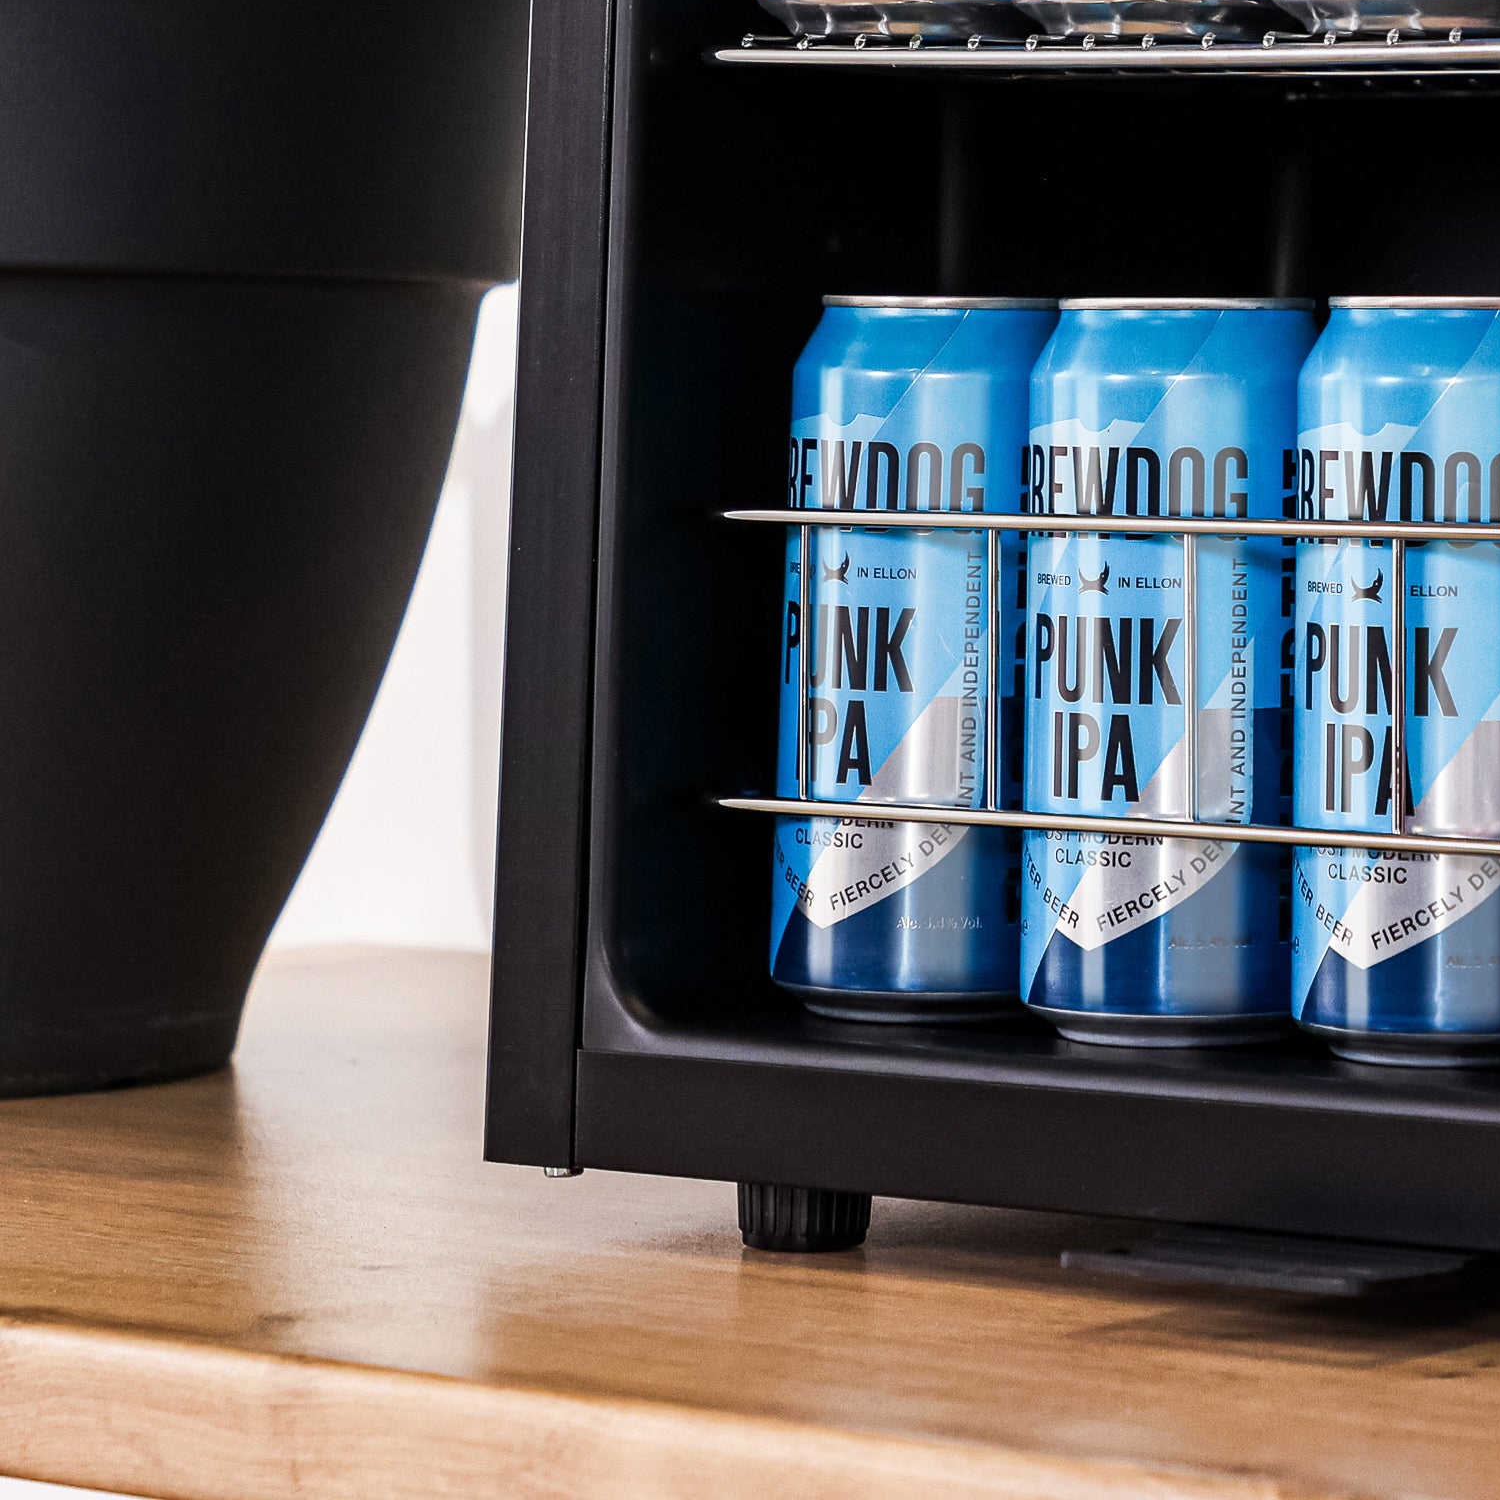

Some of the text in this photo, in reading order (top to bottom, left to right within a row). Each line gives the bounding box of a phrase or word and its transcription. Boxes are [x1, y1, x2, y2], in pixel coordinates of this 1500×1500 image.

[787, 437, 986, 536] REWDOG
[1028, 444, 1248, 542] REWDOG
[857, 567, 868, 578] IN
[873, 567, 917, 580] ELLON
[1037, 572, 1182, 589] BREWED IN ELLON
[1307, 580, 1458, 597] BREWED ELLON
[962, 551, 982, 707] INDEPENDENT
[1231, 558, 1248, 719] INDEPENDENT
[1035, 612, 1183, 706] PUNK
[1305, 621, 1459, 718] PUNK
[795, 696, 872, 786] PA
[962, 717, 977, 763] AND
[1053, 711, 1140, 803] IPA
[1230, 729, 1246, 776] AND
[1325, 723, 1415, 816] IPA
[795, 827, 863, 850] CLASSIC
[1055, 848, 1132, 869] CLASSIC
[785, 866, 815, 907] BEER
[829, 852, 915, 910] FIERCELY
[1096, 869, 1187, 932] FIERCELY
[1328, 863, 1408, 884] CLASSIC
[1043, 888, 1080, 929] BEER
[1316, 904, 1354, 946] BEER
[1371, 886, 1464, 950] FIERCELY
